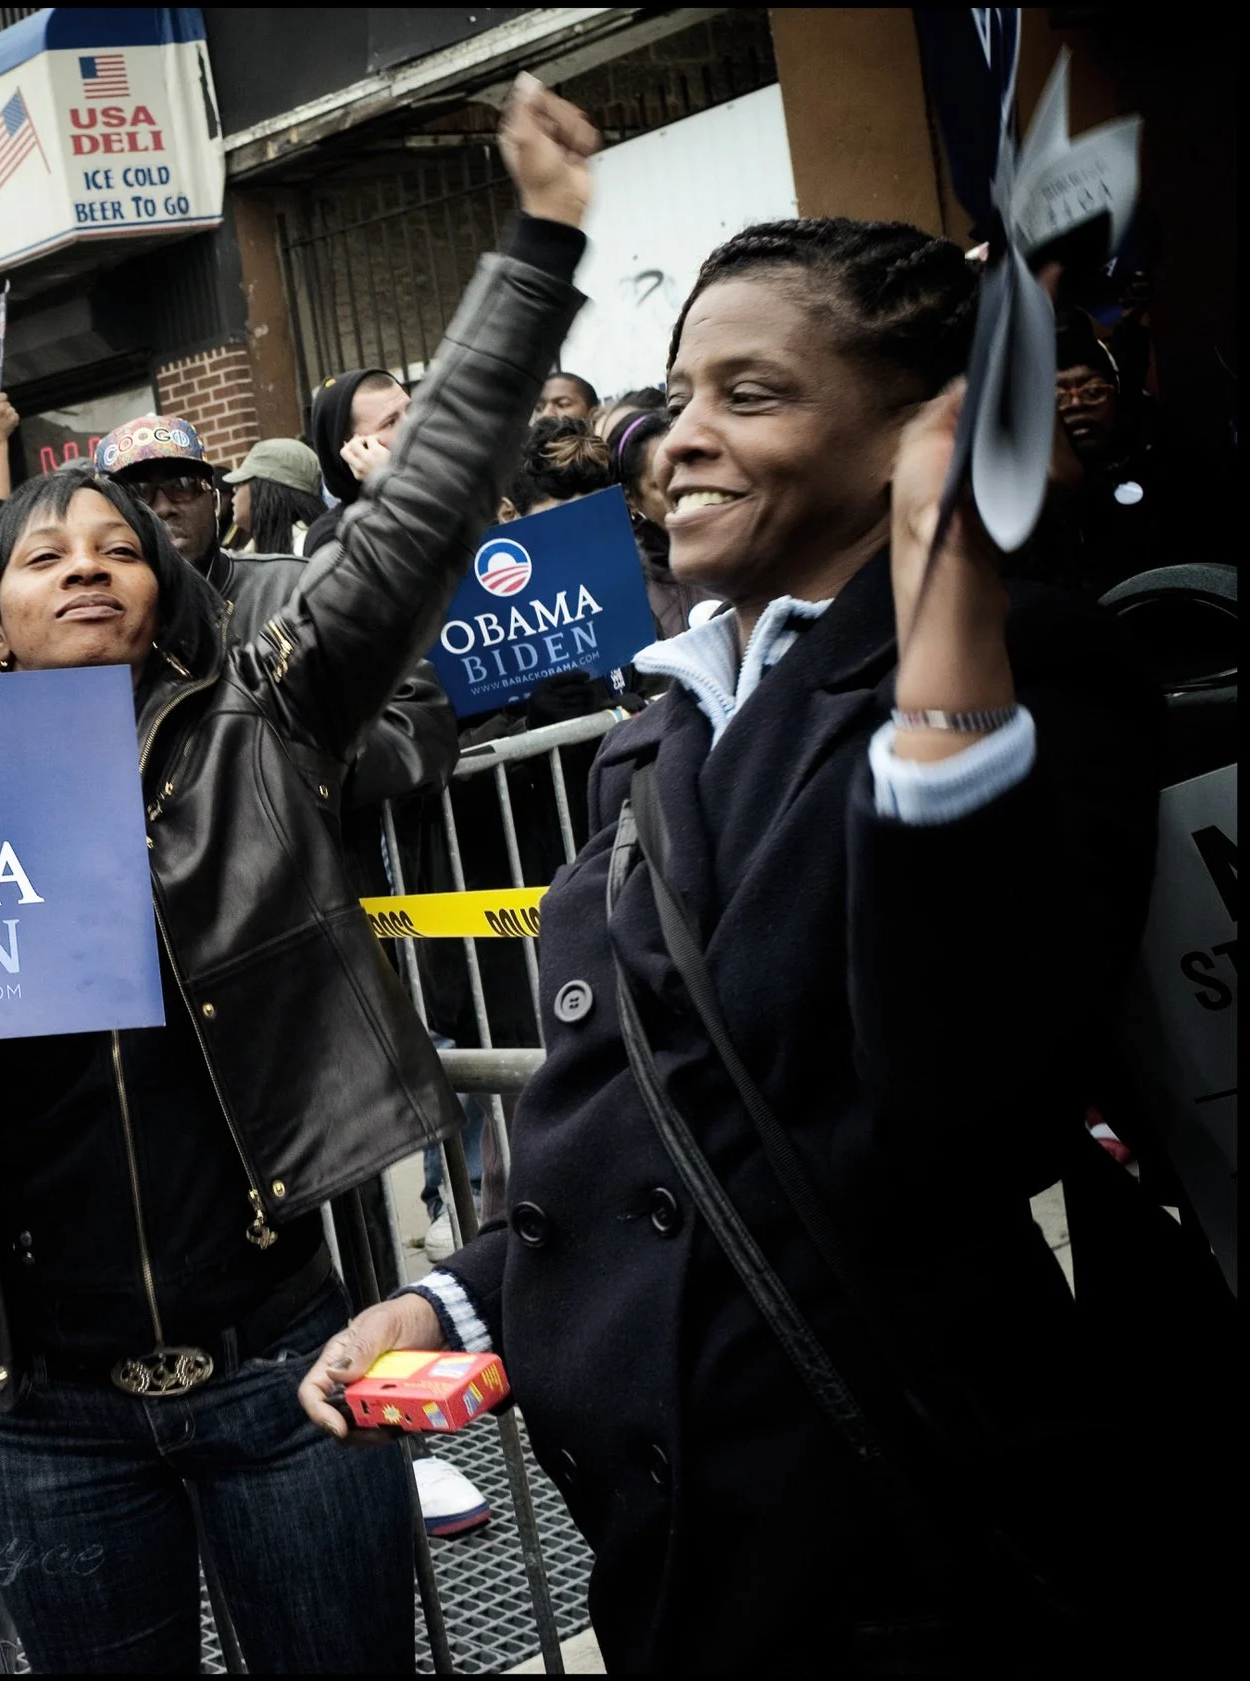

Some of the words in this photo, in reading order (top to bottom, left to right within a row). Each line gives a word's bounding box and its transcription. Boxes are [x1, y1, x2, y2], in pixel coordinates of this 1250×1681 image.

[69, 105, 157, 129] USA
[70, 130, 165, 156] DELI
[83, 169, 114, 190] ICE
[123, 166, 170, 188] COLD
[74, 201, 125, 223] BEER
[131, 196, 156, 218] TO
[164, 196, 190, 215] GO
[440, 584, 603, 655] OBAMA
[461, 620, 598, 685] BIDEN
